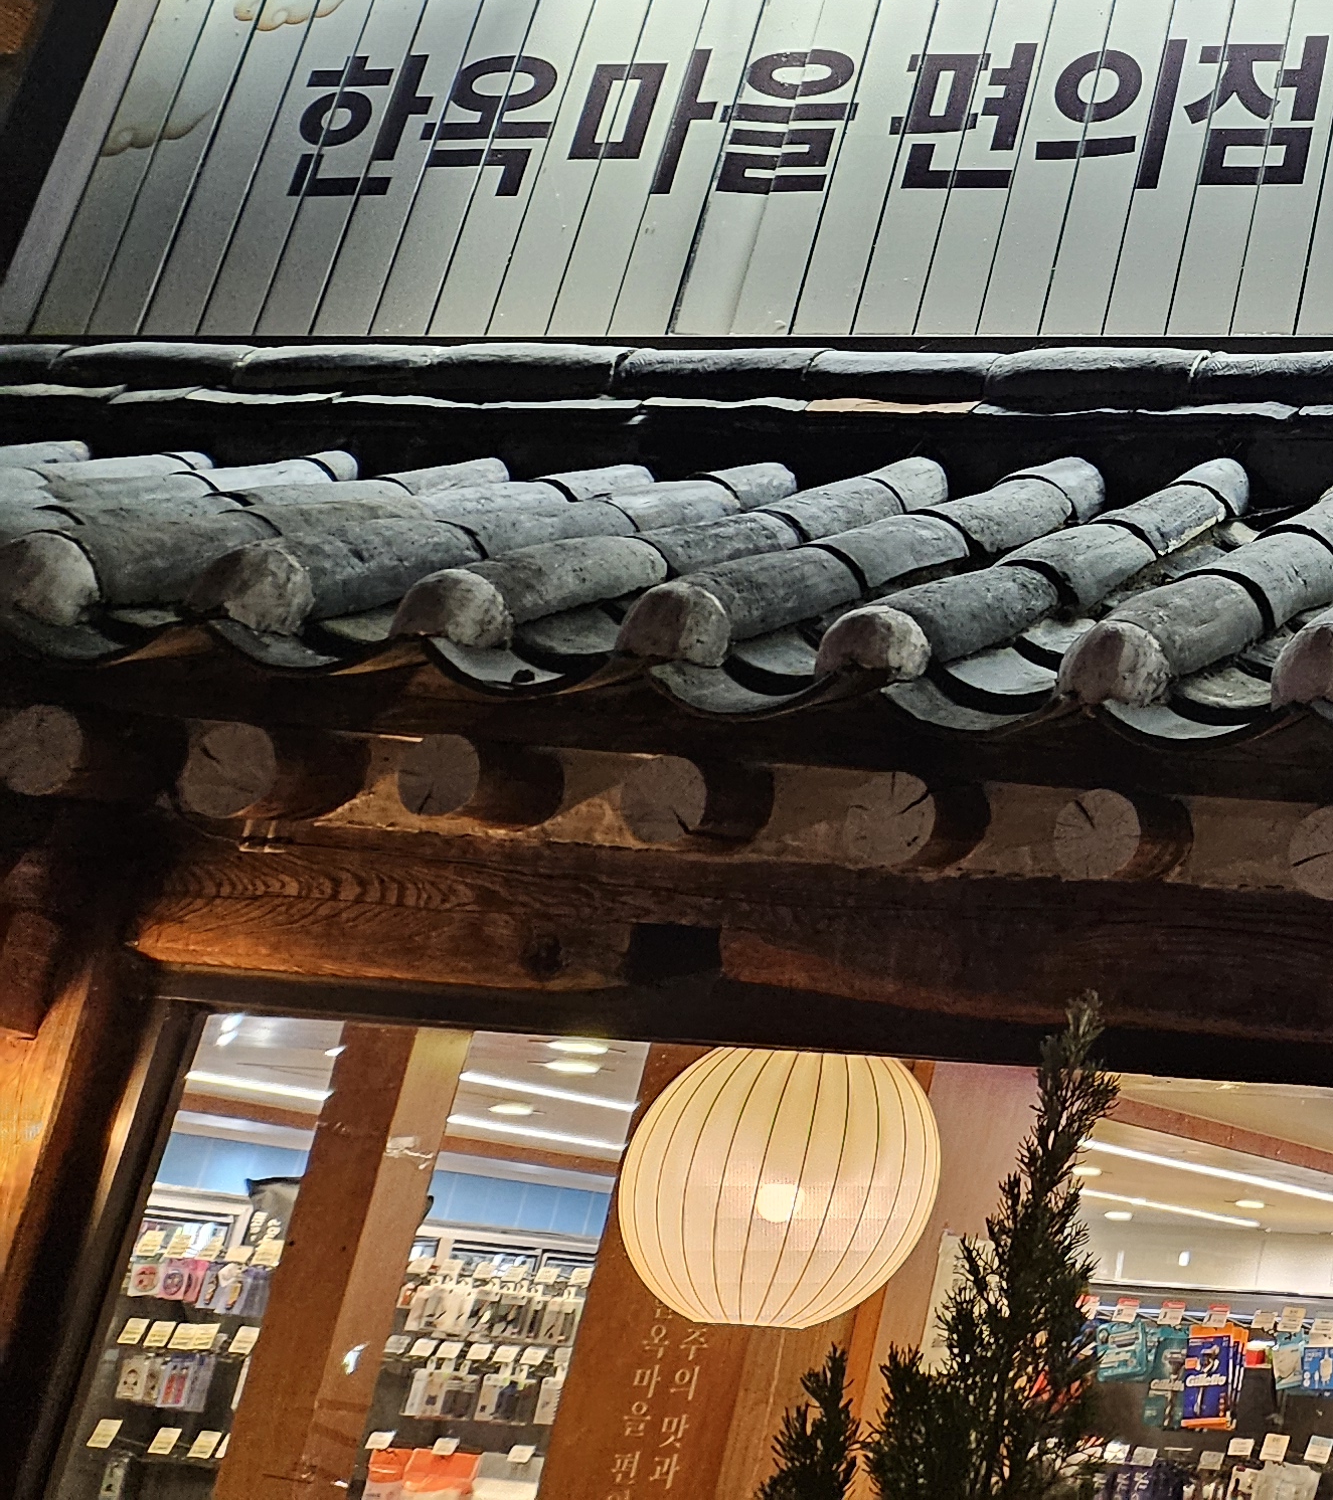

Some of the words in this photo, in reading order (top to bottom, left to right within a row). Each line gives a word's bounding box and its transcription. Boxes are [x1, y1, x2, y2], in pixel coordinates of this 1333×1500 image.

[286, 48, 859, 197] 한옥마을
[889, 34, 1330, 190] 편의점
[1185, 1375, 1227, 1388] Gillette
[649, 1413, 690, 1490] 맛과
